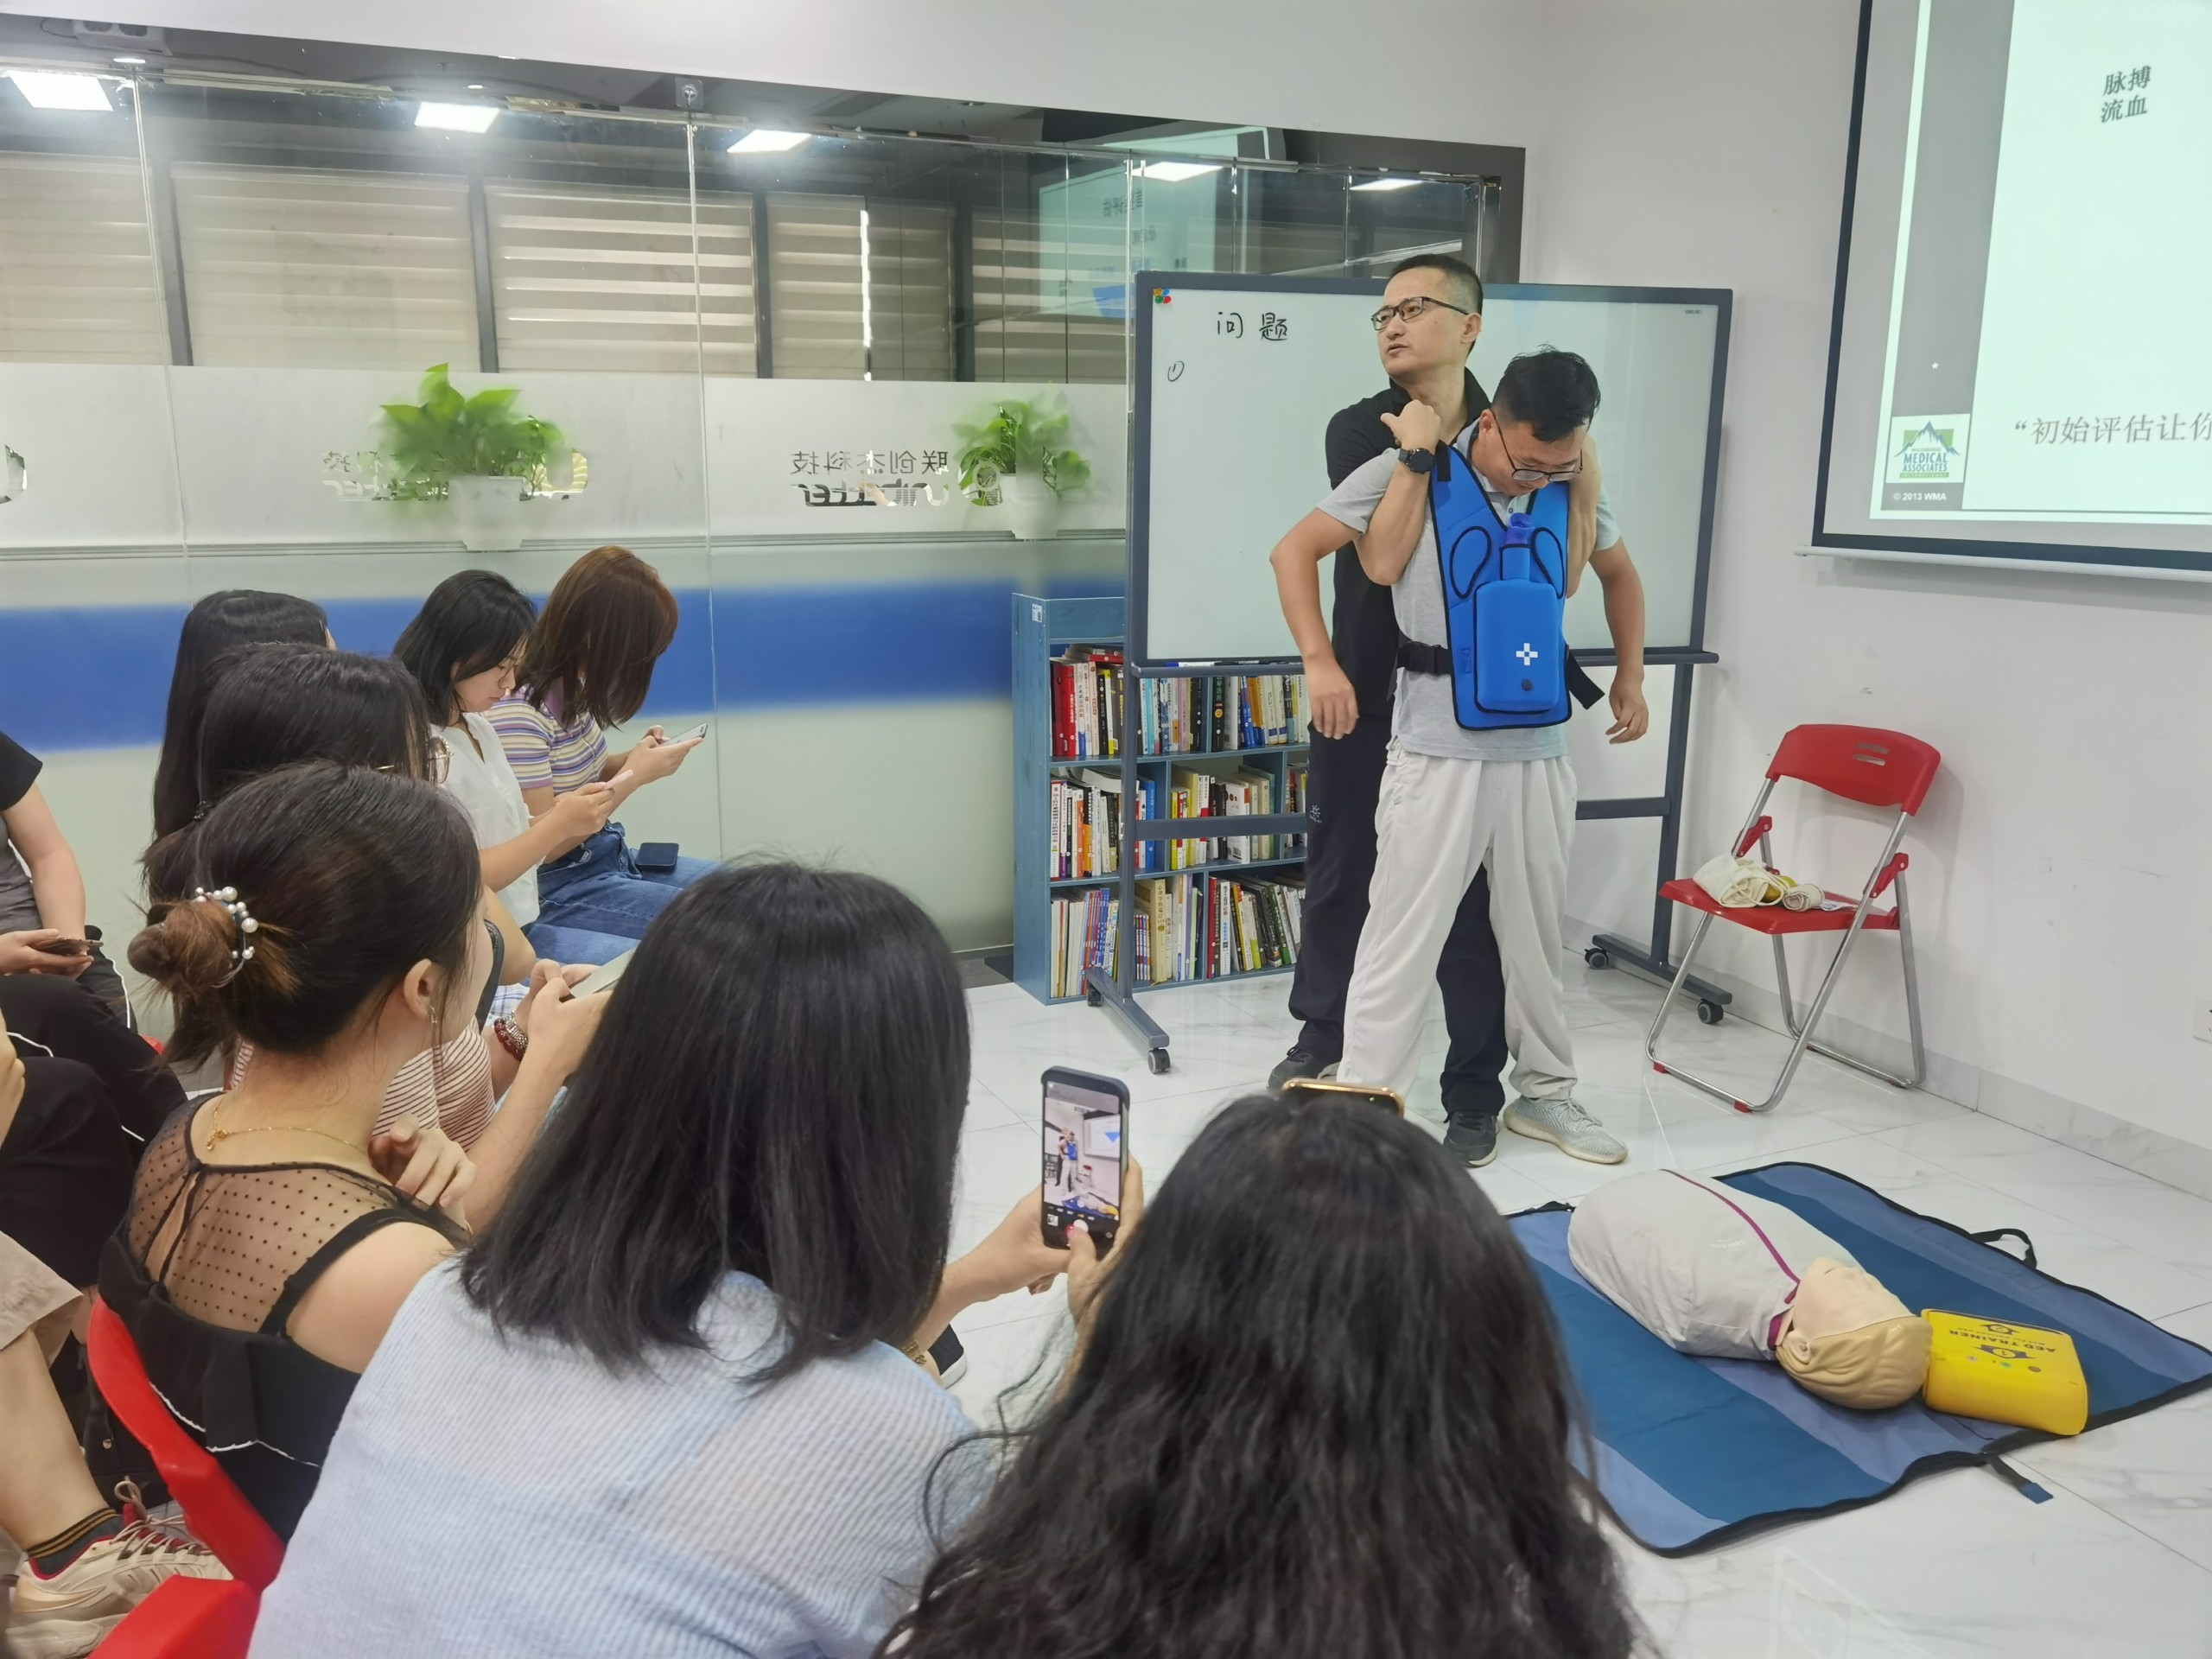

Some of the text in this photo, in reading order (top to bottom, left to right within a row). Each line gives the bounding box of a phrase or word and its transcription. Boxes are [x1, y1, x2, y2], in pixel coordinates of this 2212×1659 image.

[2102, 66, 2152, 96] 脉搏
[2101, 94, 2147, 123] 流血
[1217, 312, 1288, 341] 问题
[1903, 463, 1948, 473] ASSOCIATES
[1904, 452, 1948, 464] MEDICAL
[1903, 493, 1922, 501] 2013
[1924, 493, 1947, 501] WMA
[1949, 1330, 2056, 1353] AED TRAINER
